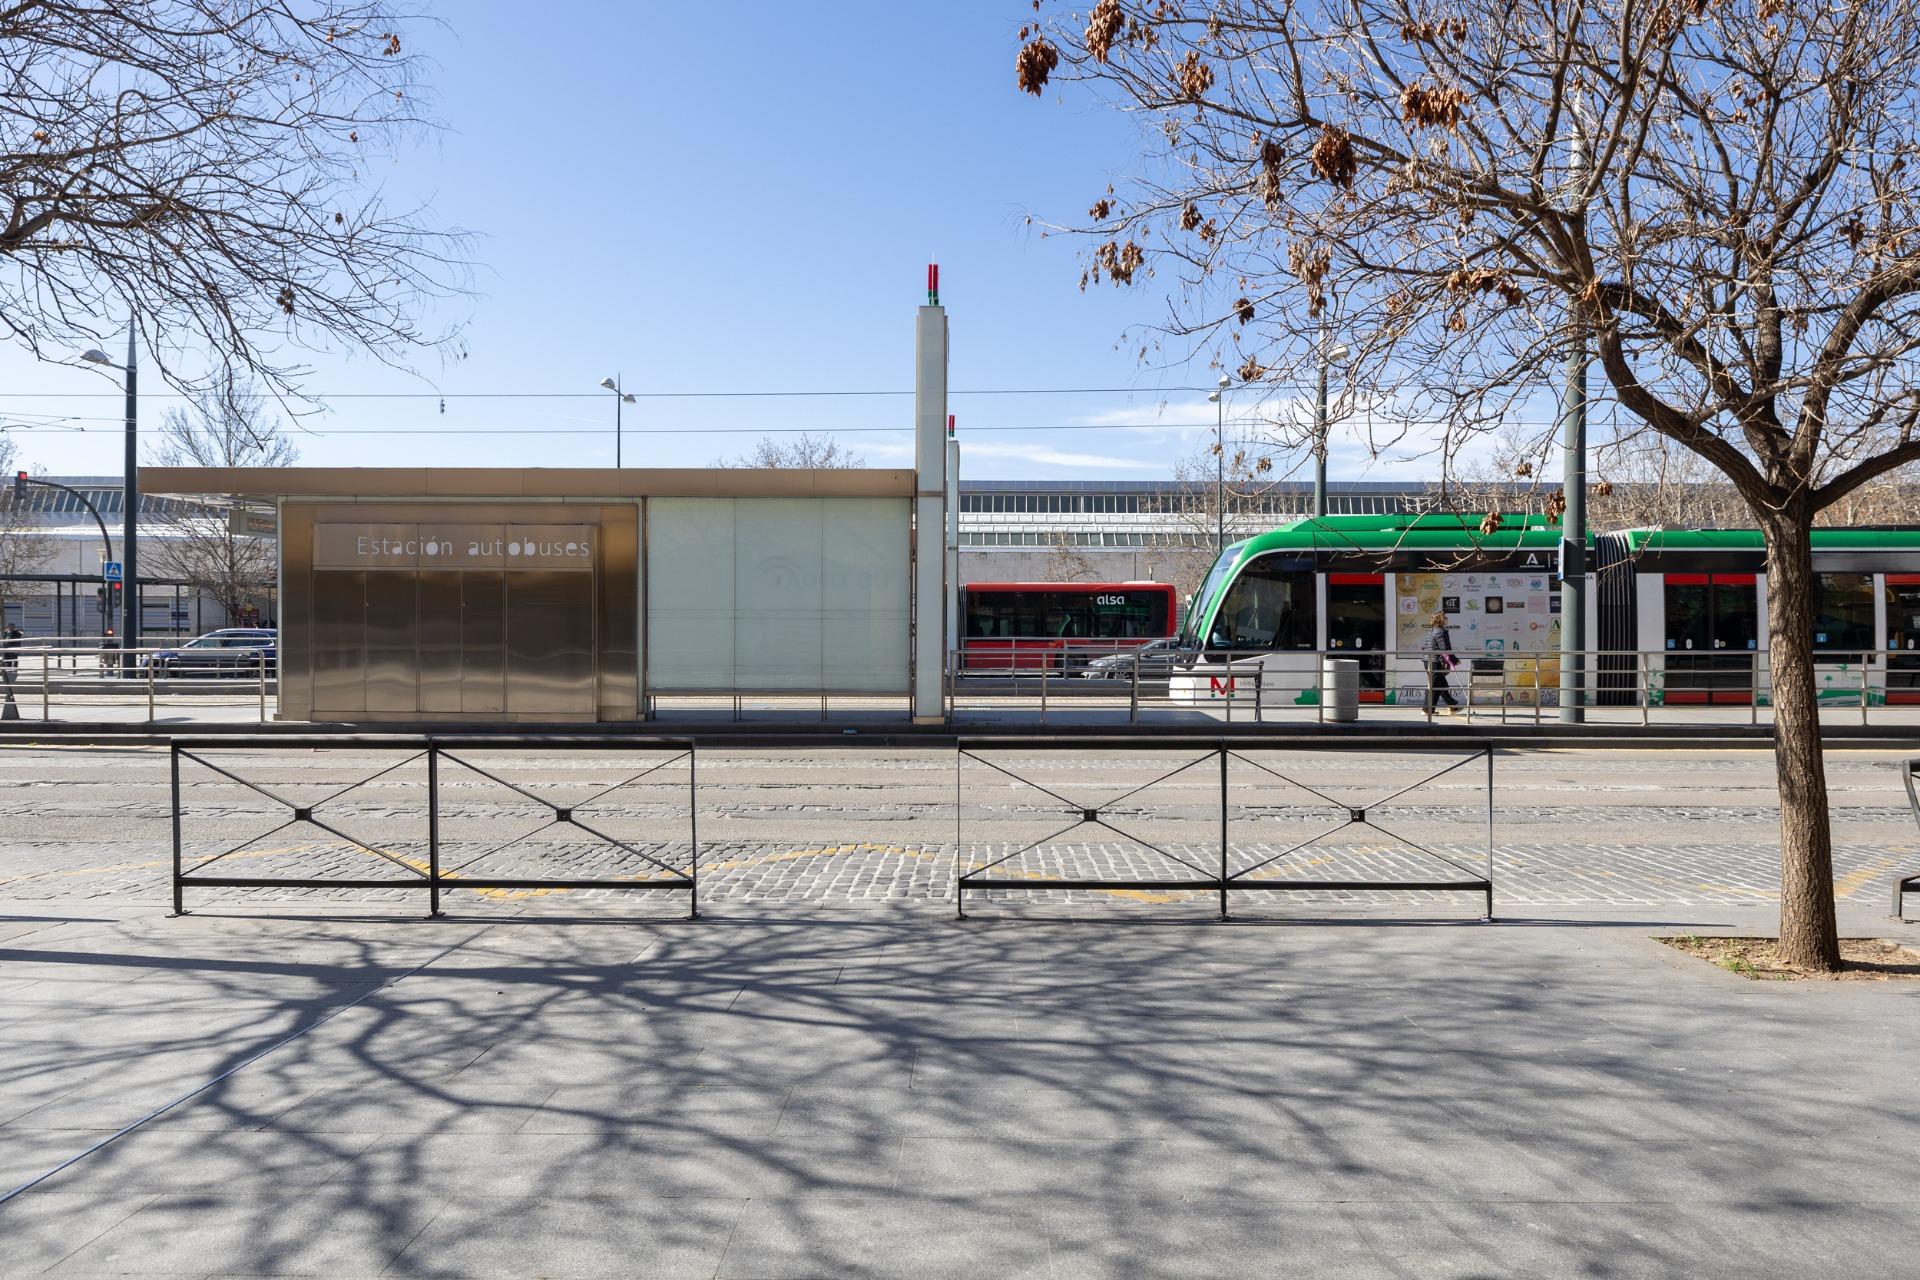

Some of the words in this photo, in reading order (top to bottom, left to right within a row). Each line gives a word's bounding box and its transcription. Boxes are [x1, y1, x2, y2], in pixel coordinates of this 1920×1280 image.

[357, 535, 453, 556] Estación
[468, 536, 589, 556] autobuses
[1096, 595, 1124, 605] alsa
